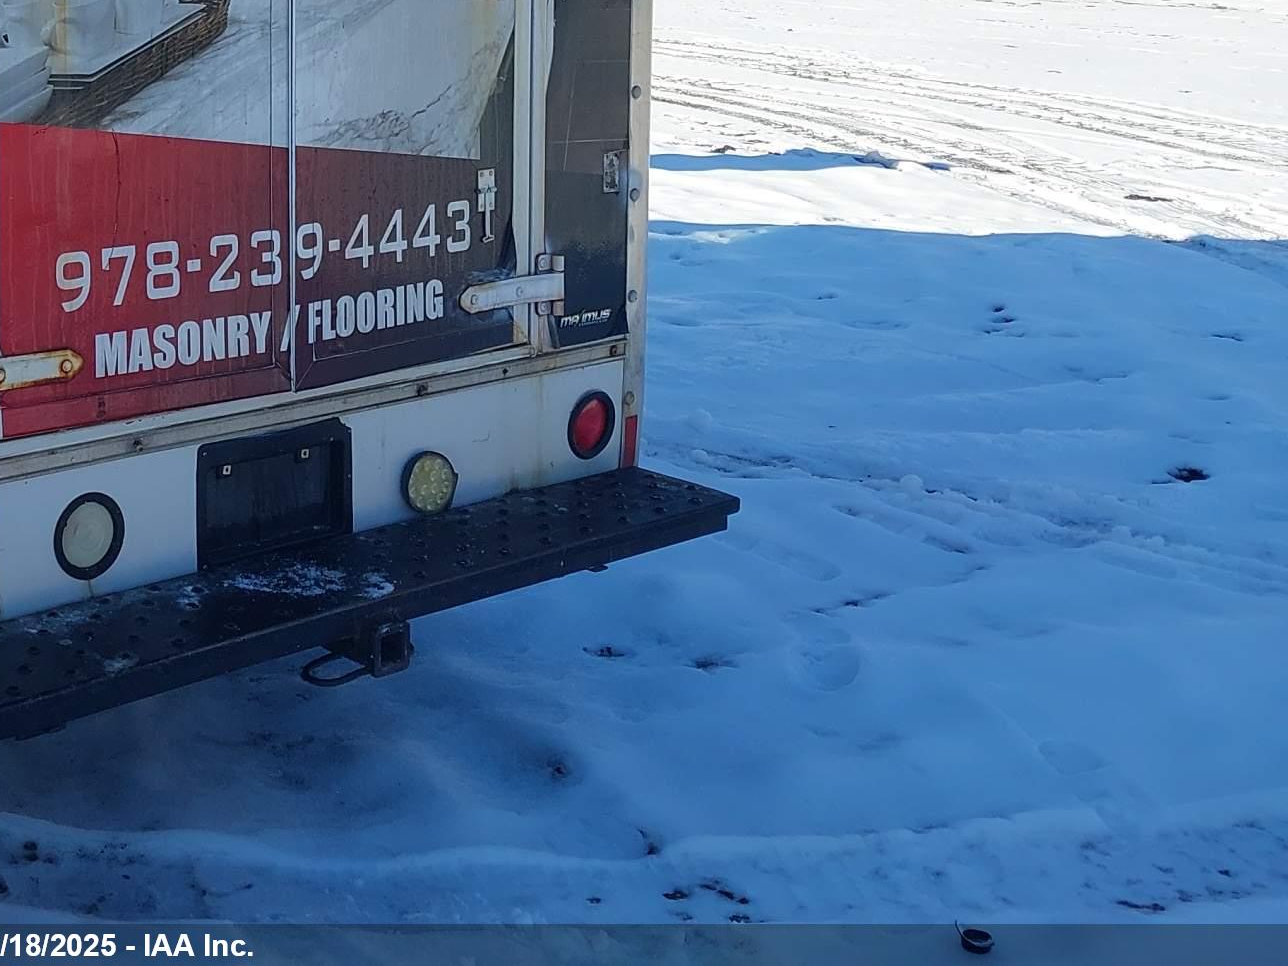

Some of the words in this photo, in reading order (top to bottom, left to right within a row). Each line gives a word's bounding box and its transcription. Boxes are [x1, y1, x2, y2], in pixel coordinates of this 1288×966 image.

[55, 199, 473, 314] 978-239-4443
[94, 311, 273, 380] MASONRY
[308, 278, 445, 344] FLOORING
